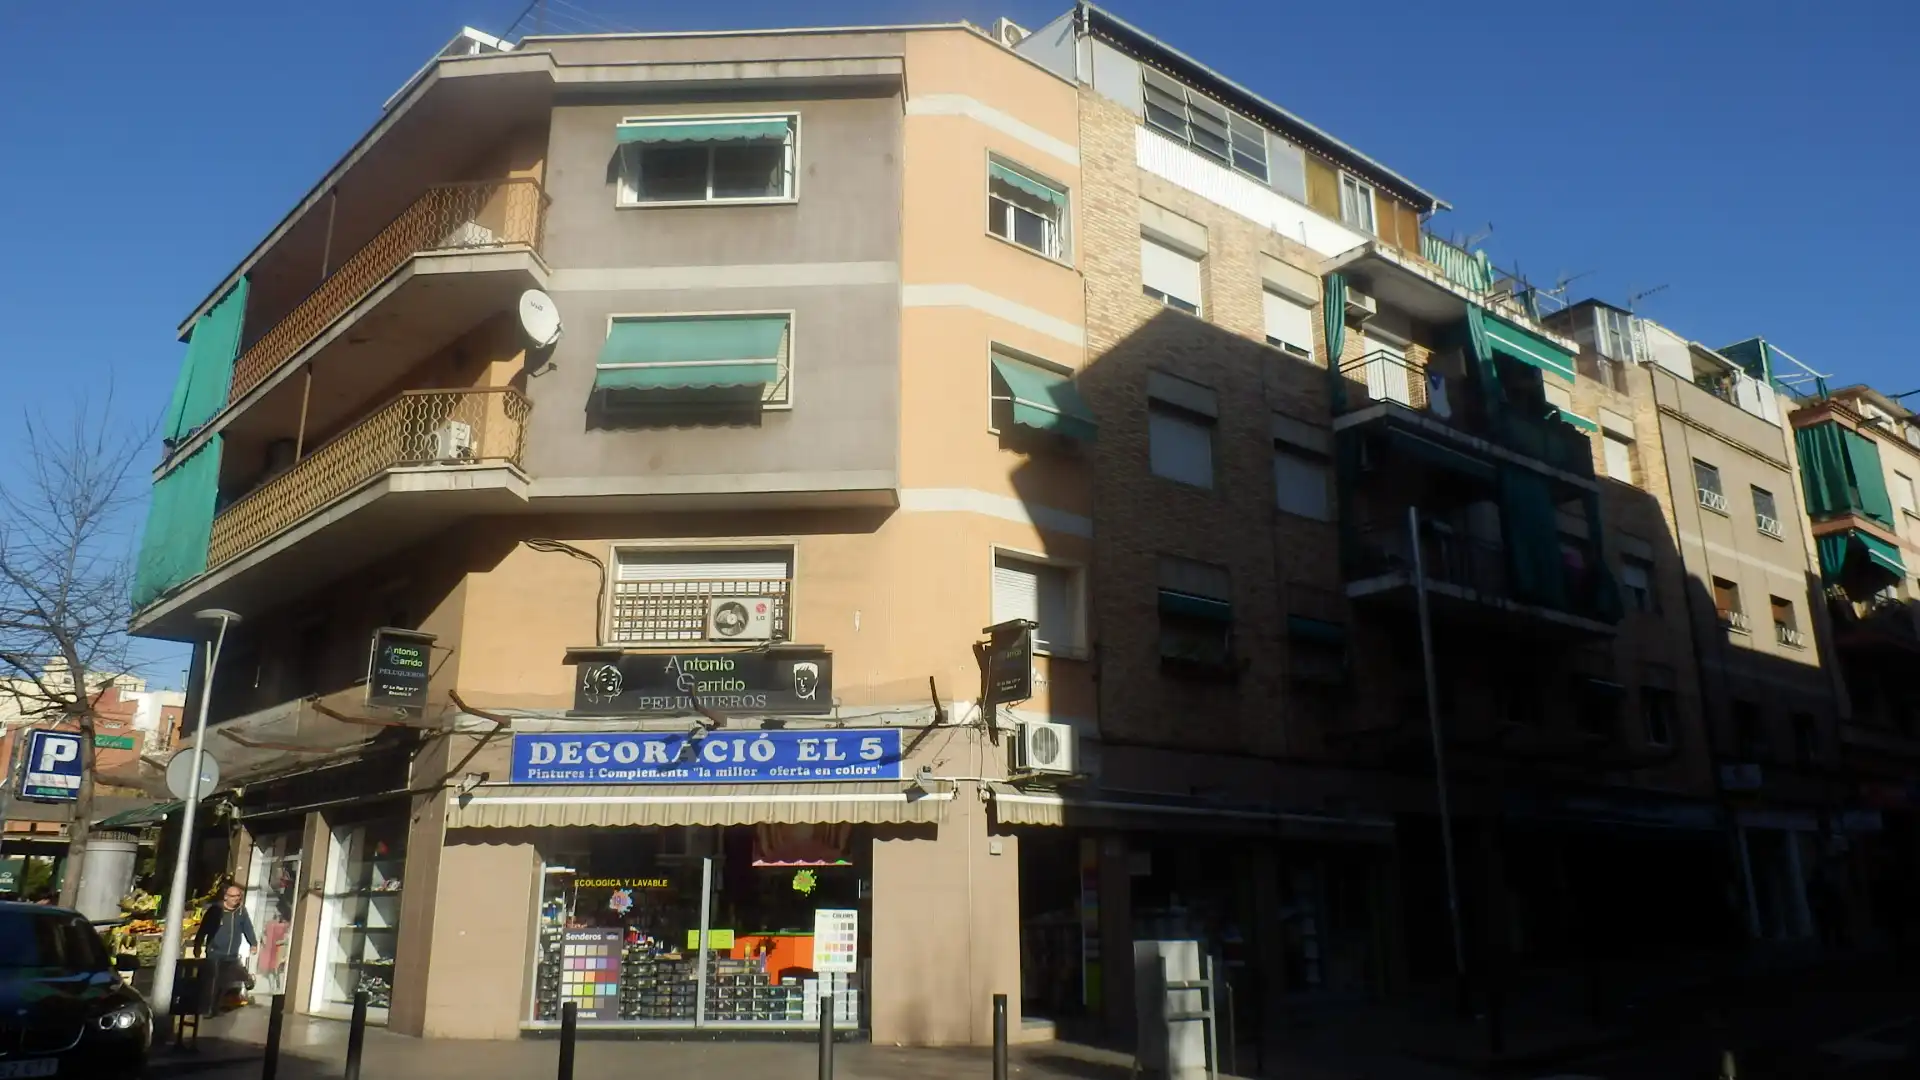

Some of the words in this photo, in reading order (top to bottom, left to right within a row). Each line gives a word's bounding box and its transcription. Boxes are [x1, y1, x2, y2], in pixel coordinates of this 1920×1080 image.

[384, 645, 419, 657] Antonio
[390, 654, 423, 667] Garrido
[664, 655, 735, 674] Antonio
[677, 673, 746, 692] Garrido
[639, 694, 766, 710] PELUQUEROS
[39, 738, 79, 772] P
[528, 733, 776, 764] DECORACIÓ
[796, 738, 847, 762] EL
[859, 737, 884, 761] 5
[527, 768, 585, 779] Pintures
[588, 768, 594, 779] i
[715, 766, 758, 777] millor
[769, 765, 811, 777] oferta
[815, 767, 831, 776] en
[624, 879, 631, 887] Y
[632, 879, 668, 887] LAVABLE
[565, 932, 602, 940] Senderos
